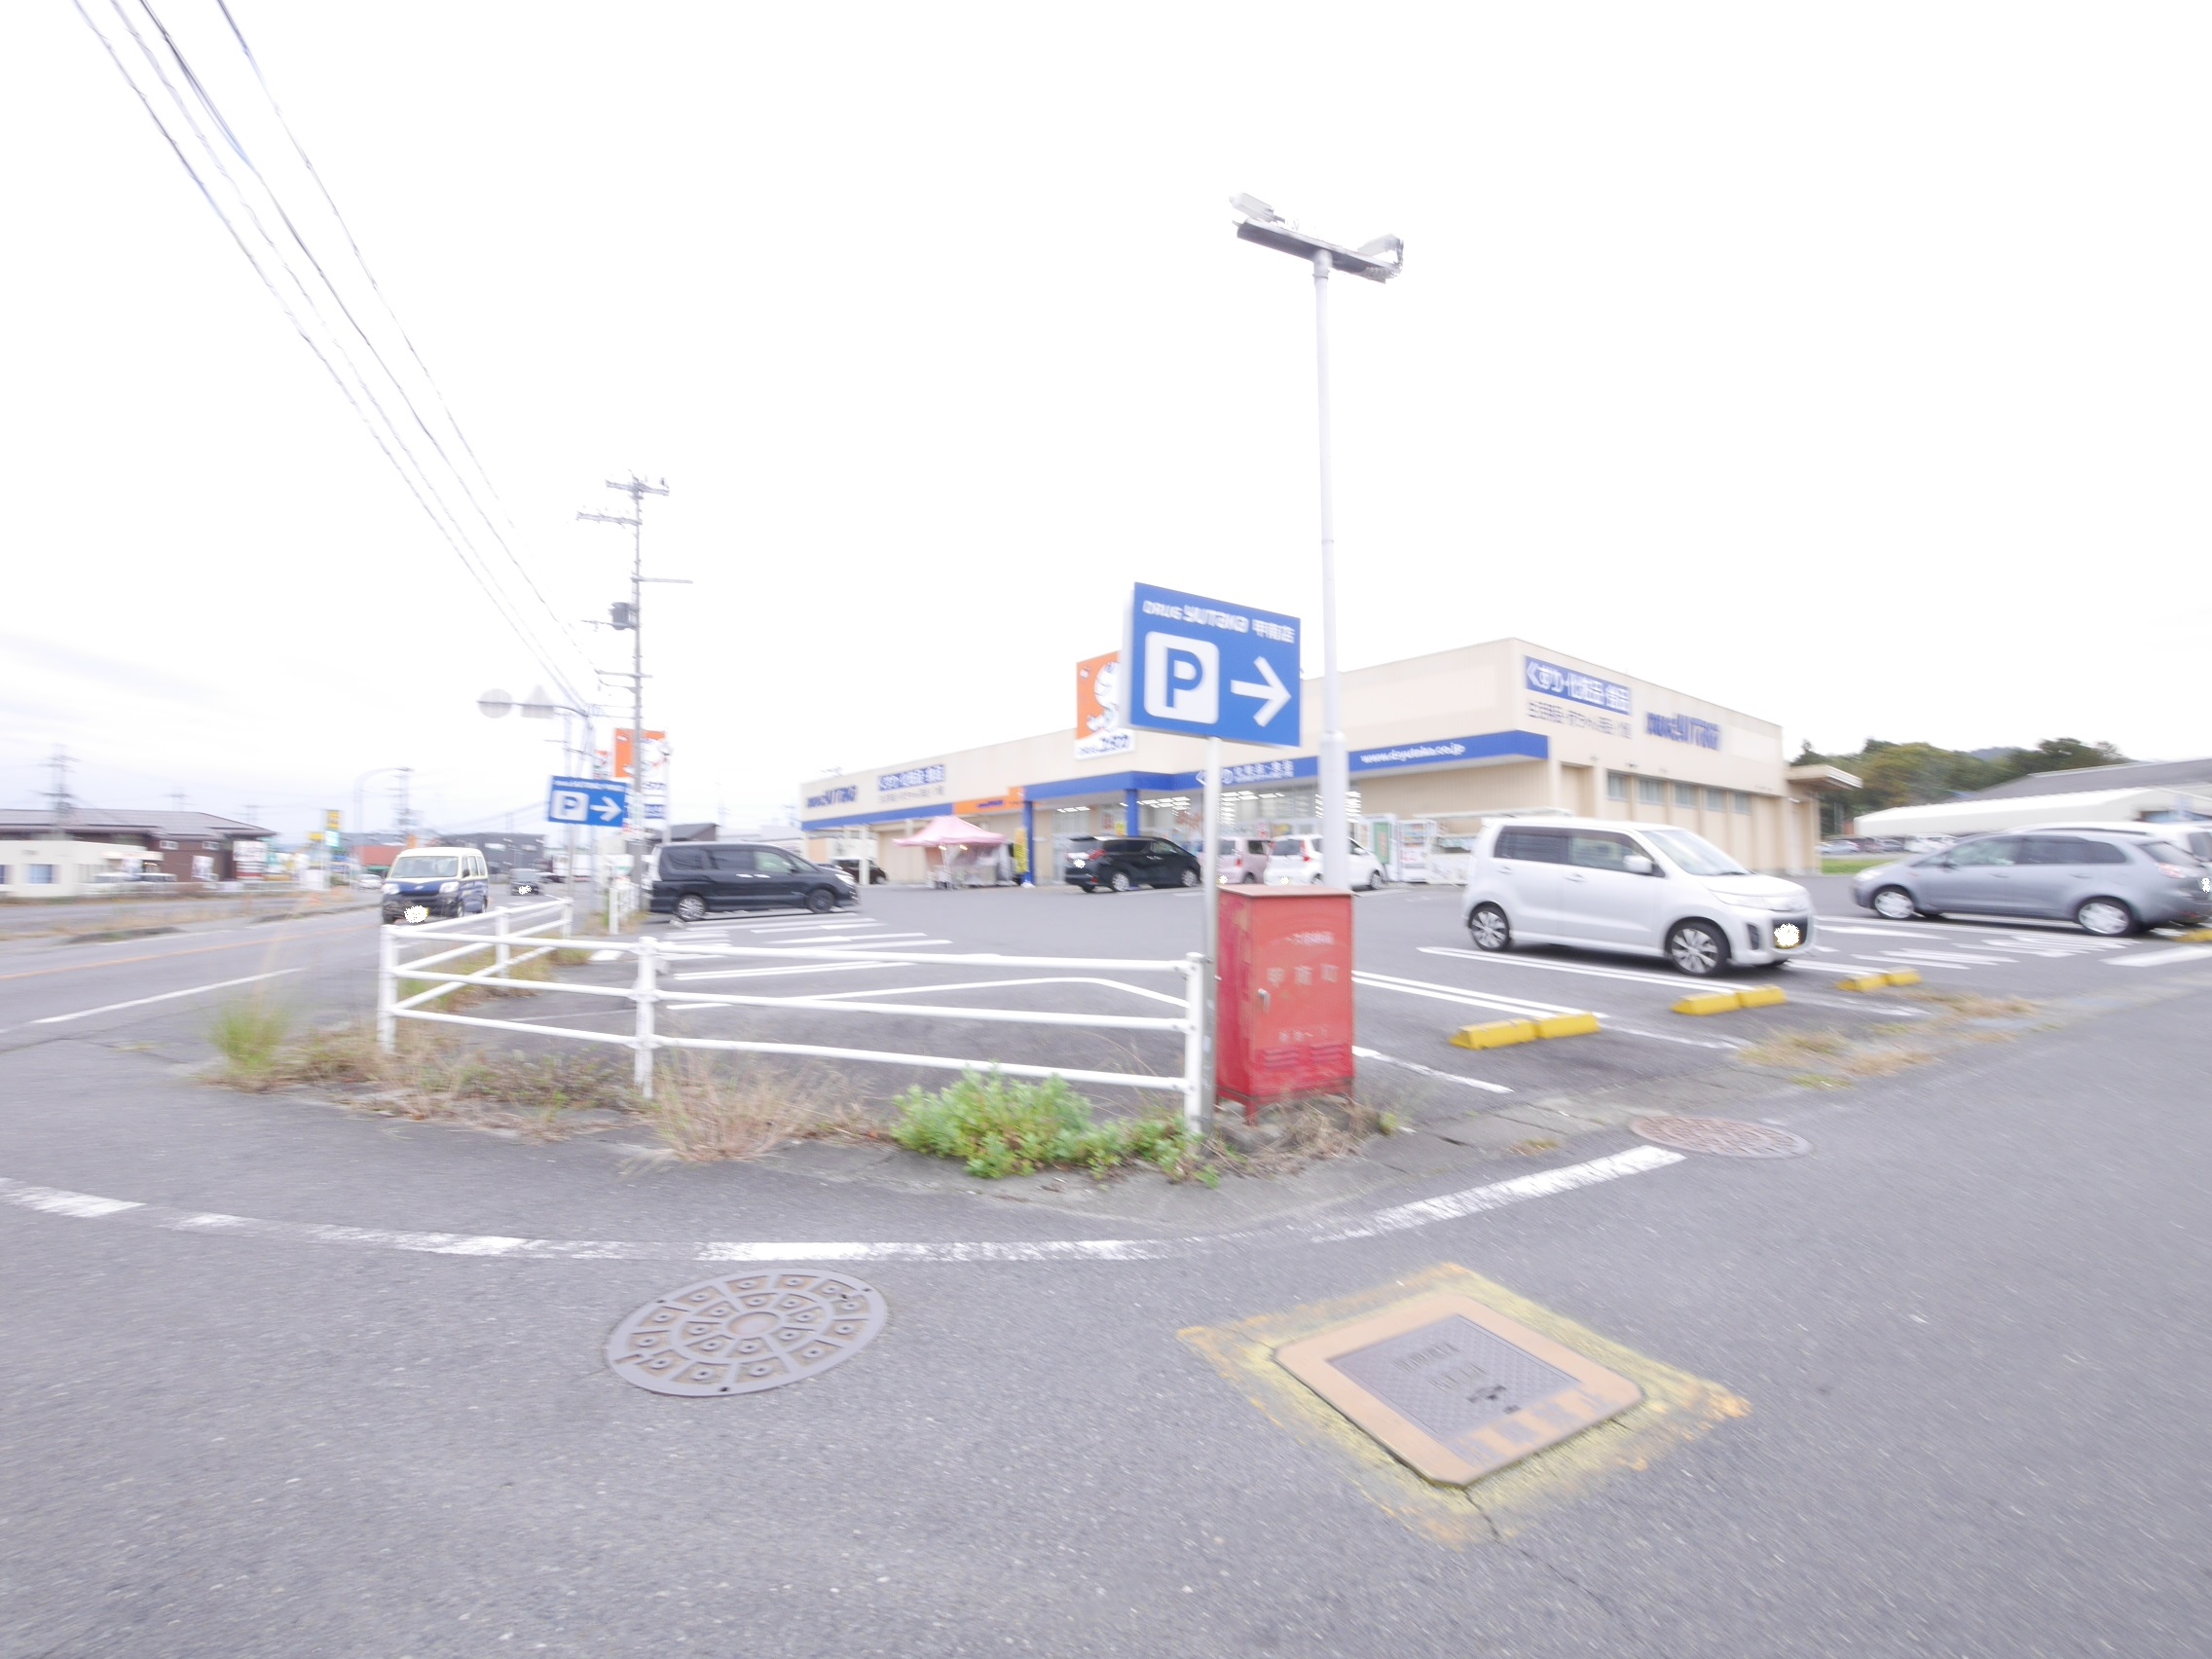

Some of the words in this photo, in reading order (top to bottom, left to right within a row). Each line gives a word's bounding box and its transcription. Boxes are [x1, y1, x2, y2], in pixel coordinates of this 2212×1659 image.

[1142, 600, 1183, 620] DRUG
[1165, 646, 1203, 709] P
[562, 795, 579, 818] P
